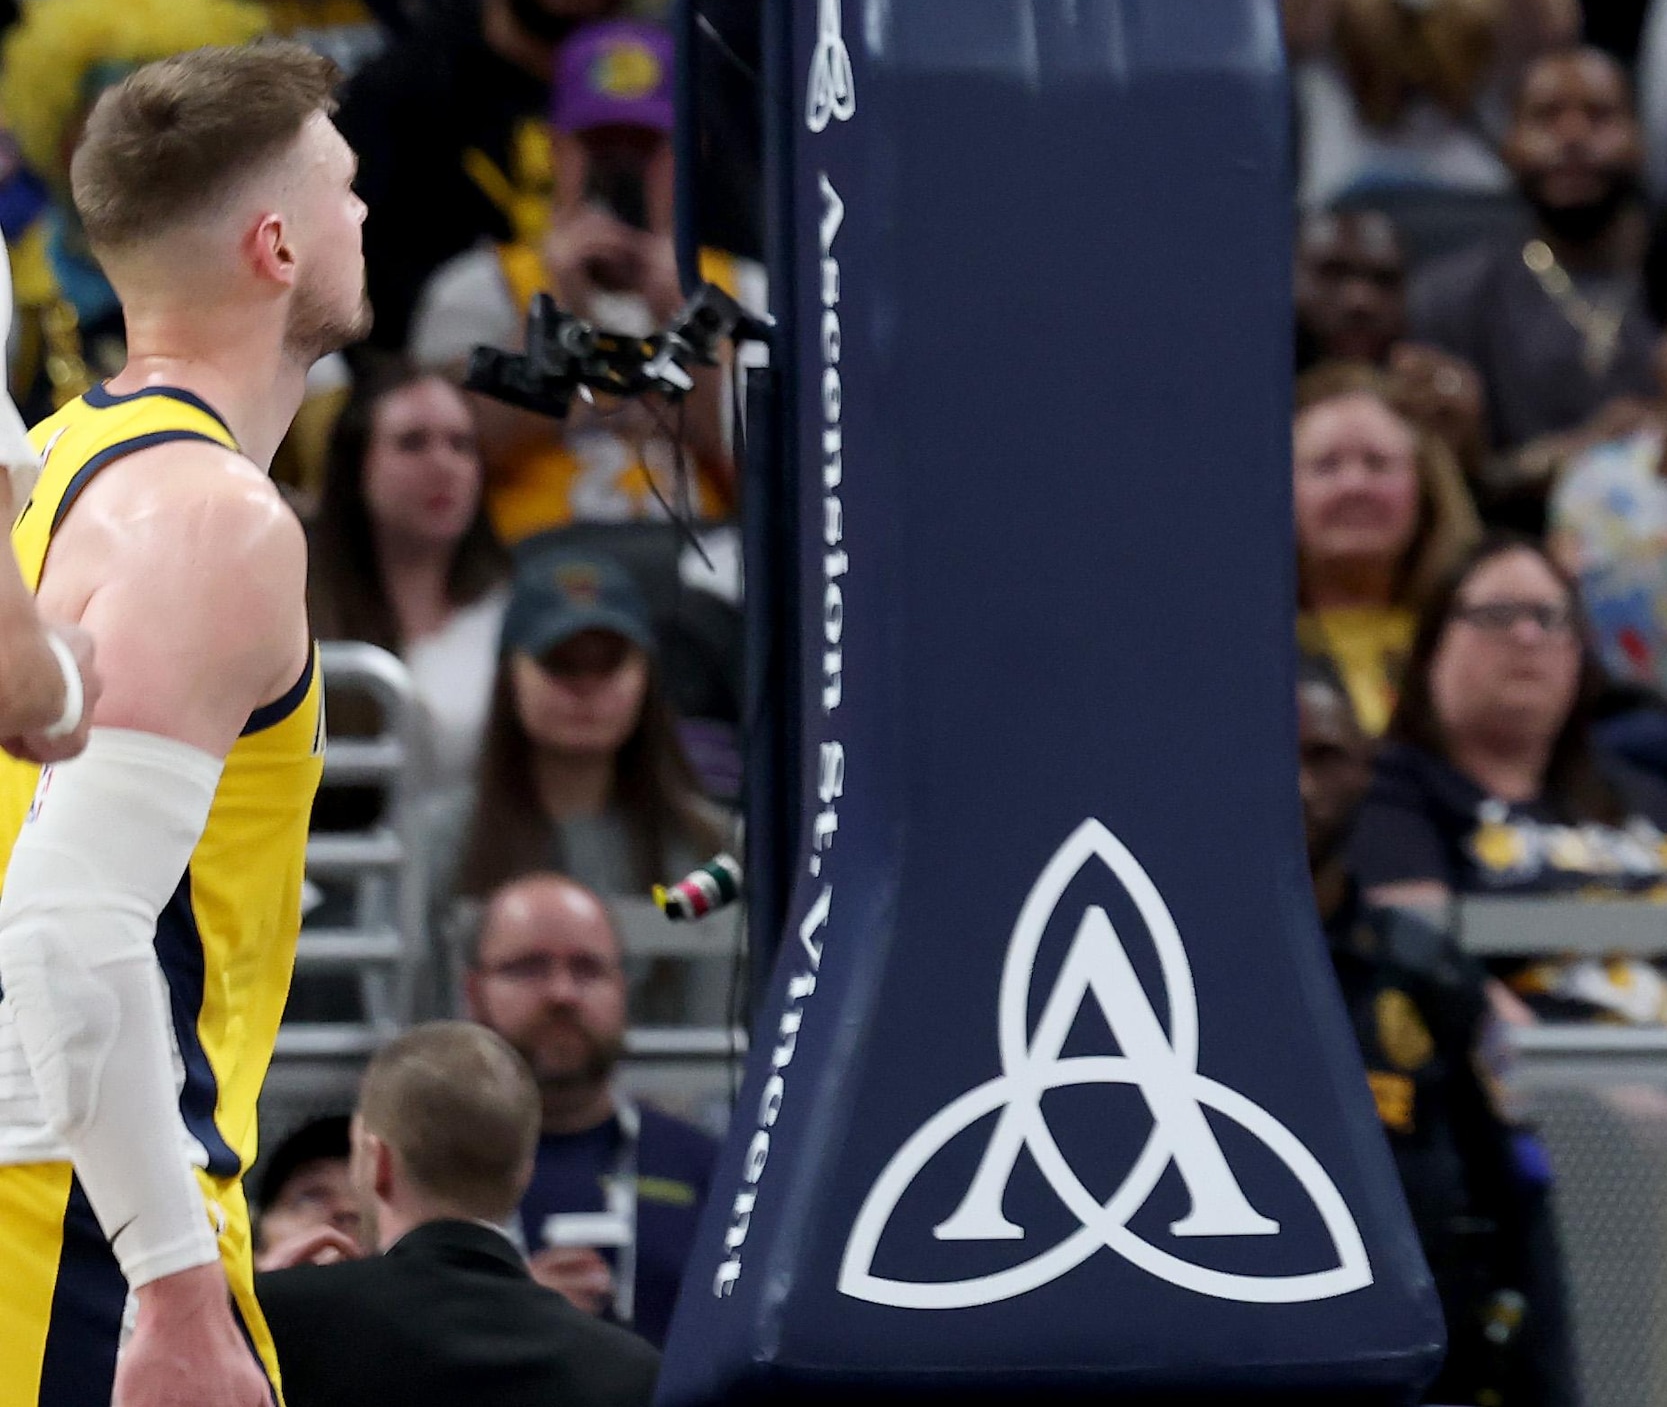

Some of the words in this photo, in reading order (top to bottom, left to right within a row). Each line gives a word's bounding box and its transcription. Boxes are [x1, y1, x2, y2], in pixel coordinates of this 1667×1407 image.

[815, 169, 849, 715] Ascension
[809, 741, 845, 878] St.
[713, 883, 834, 1299] Vincent
